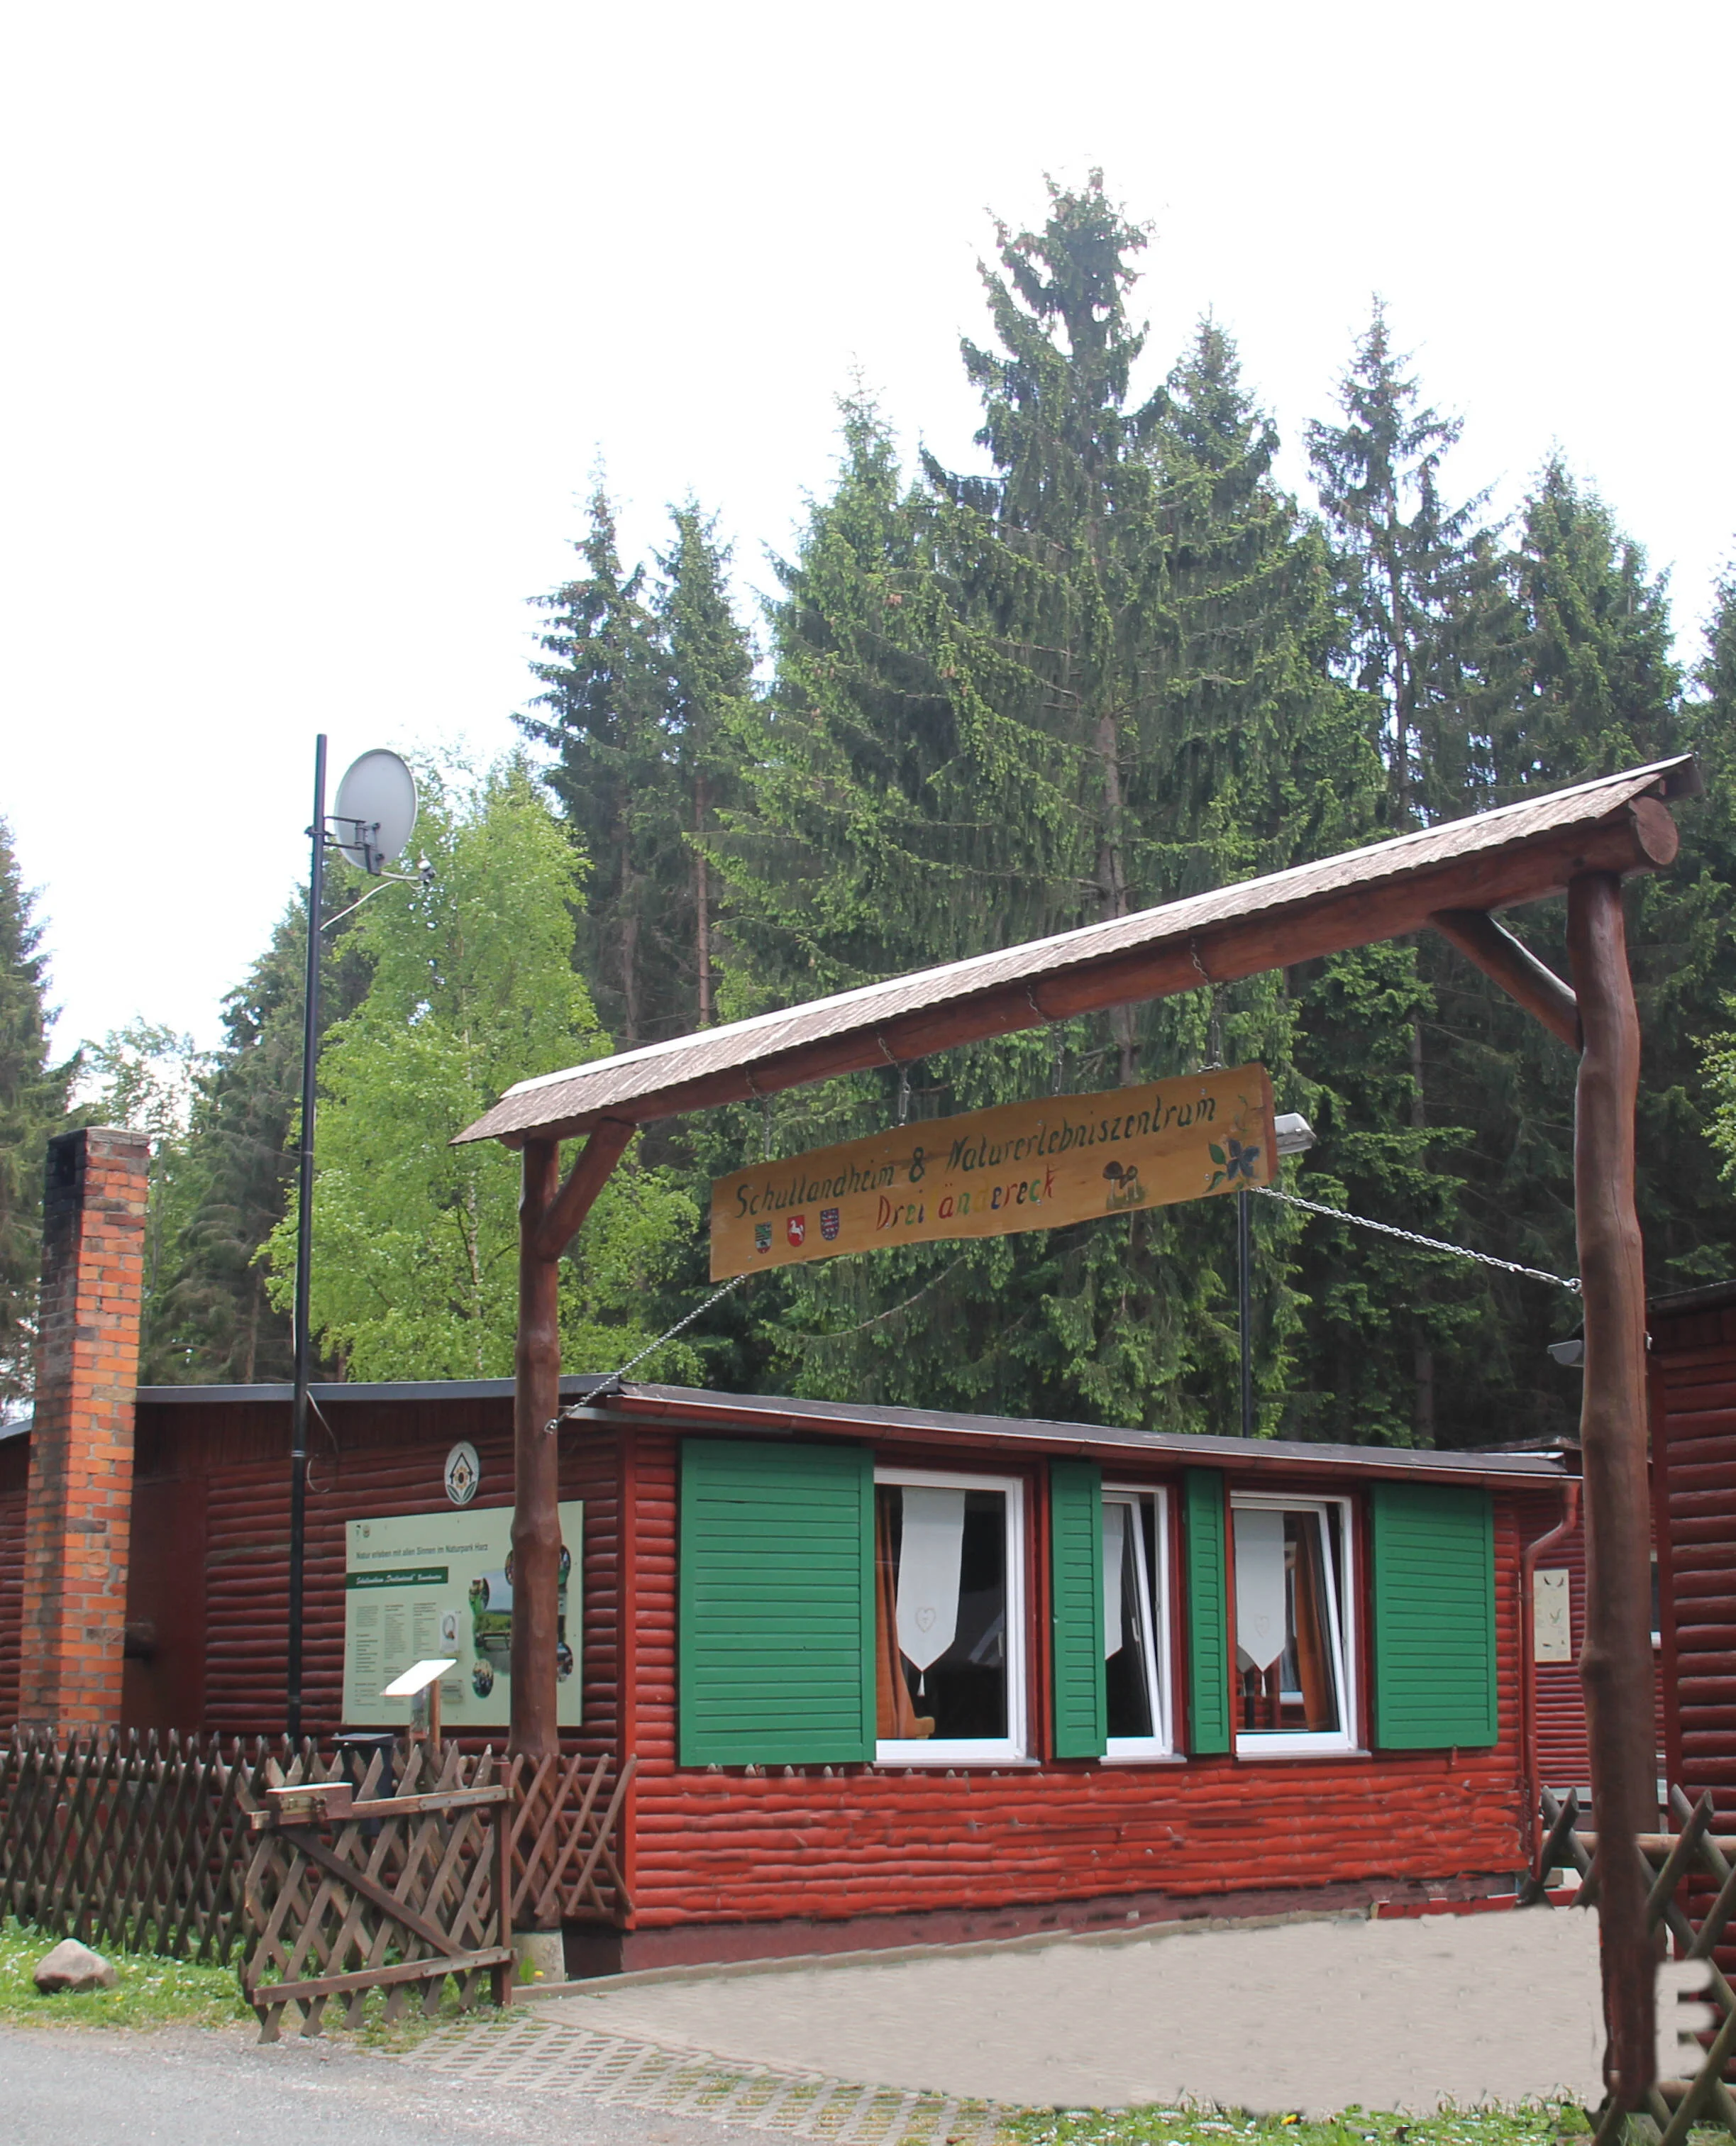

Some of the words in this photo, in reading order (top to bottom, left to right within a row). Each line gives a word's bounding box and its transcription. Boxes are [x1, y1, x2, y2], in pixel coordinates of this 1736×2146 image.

[735, 1163, 895, 1218] Schullandheim
[908, 1146, 926, 1183] &
[945, 1094, 1216, 1173] Naturerlebniszentrum
[876, 1163, 1058, 1232] Dreiländereck
